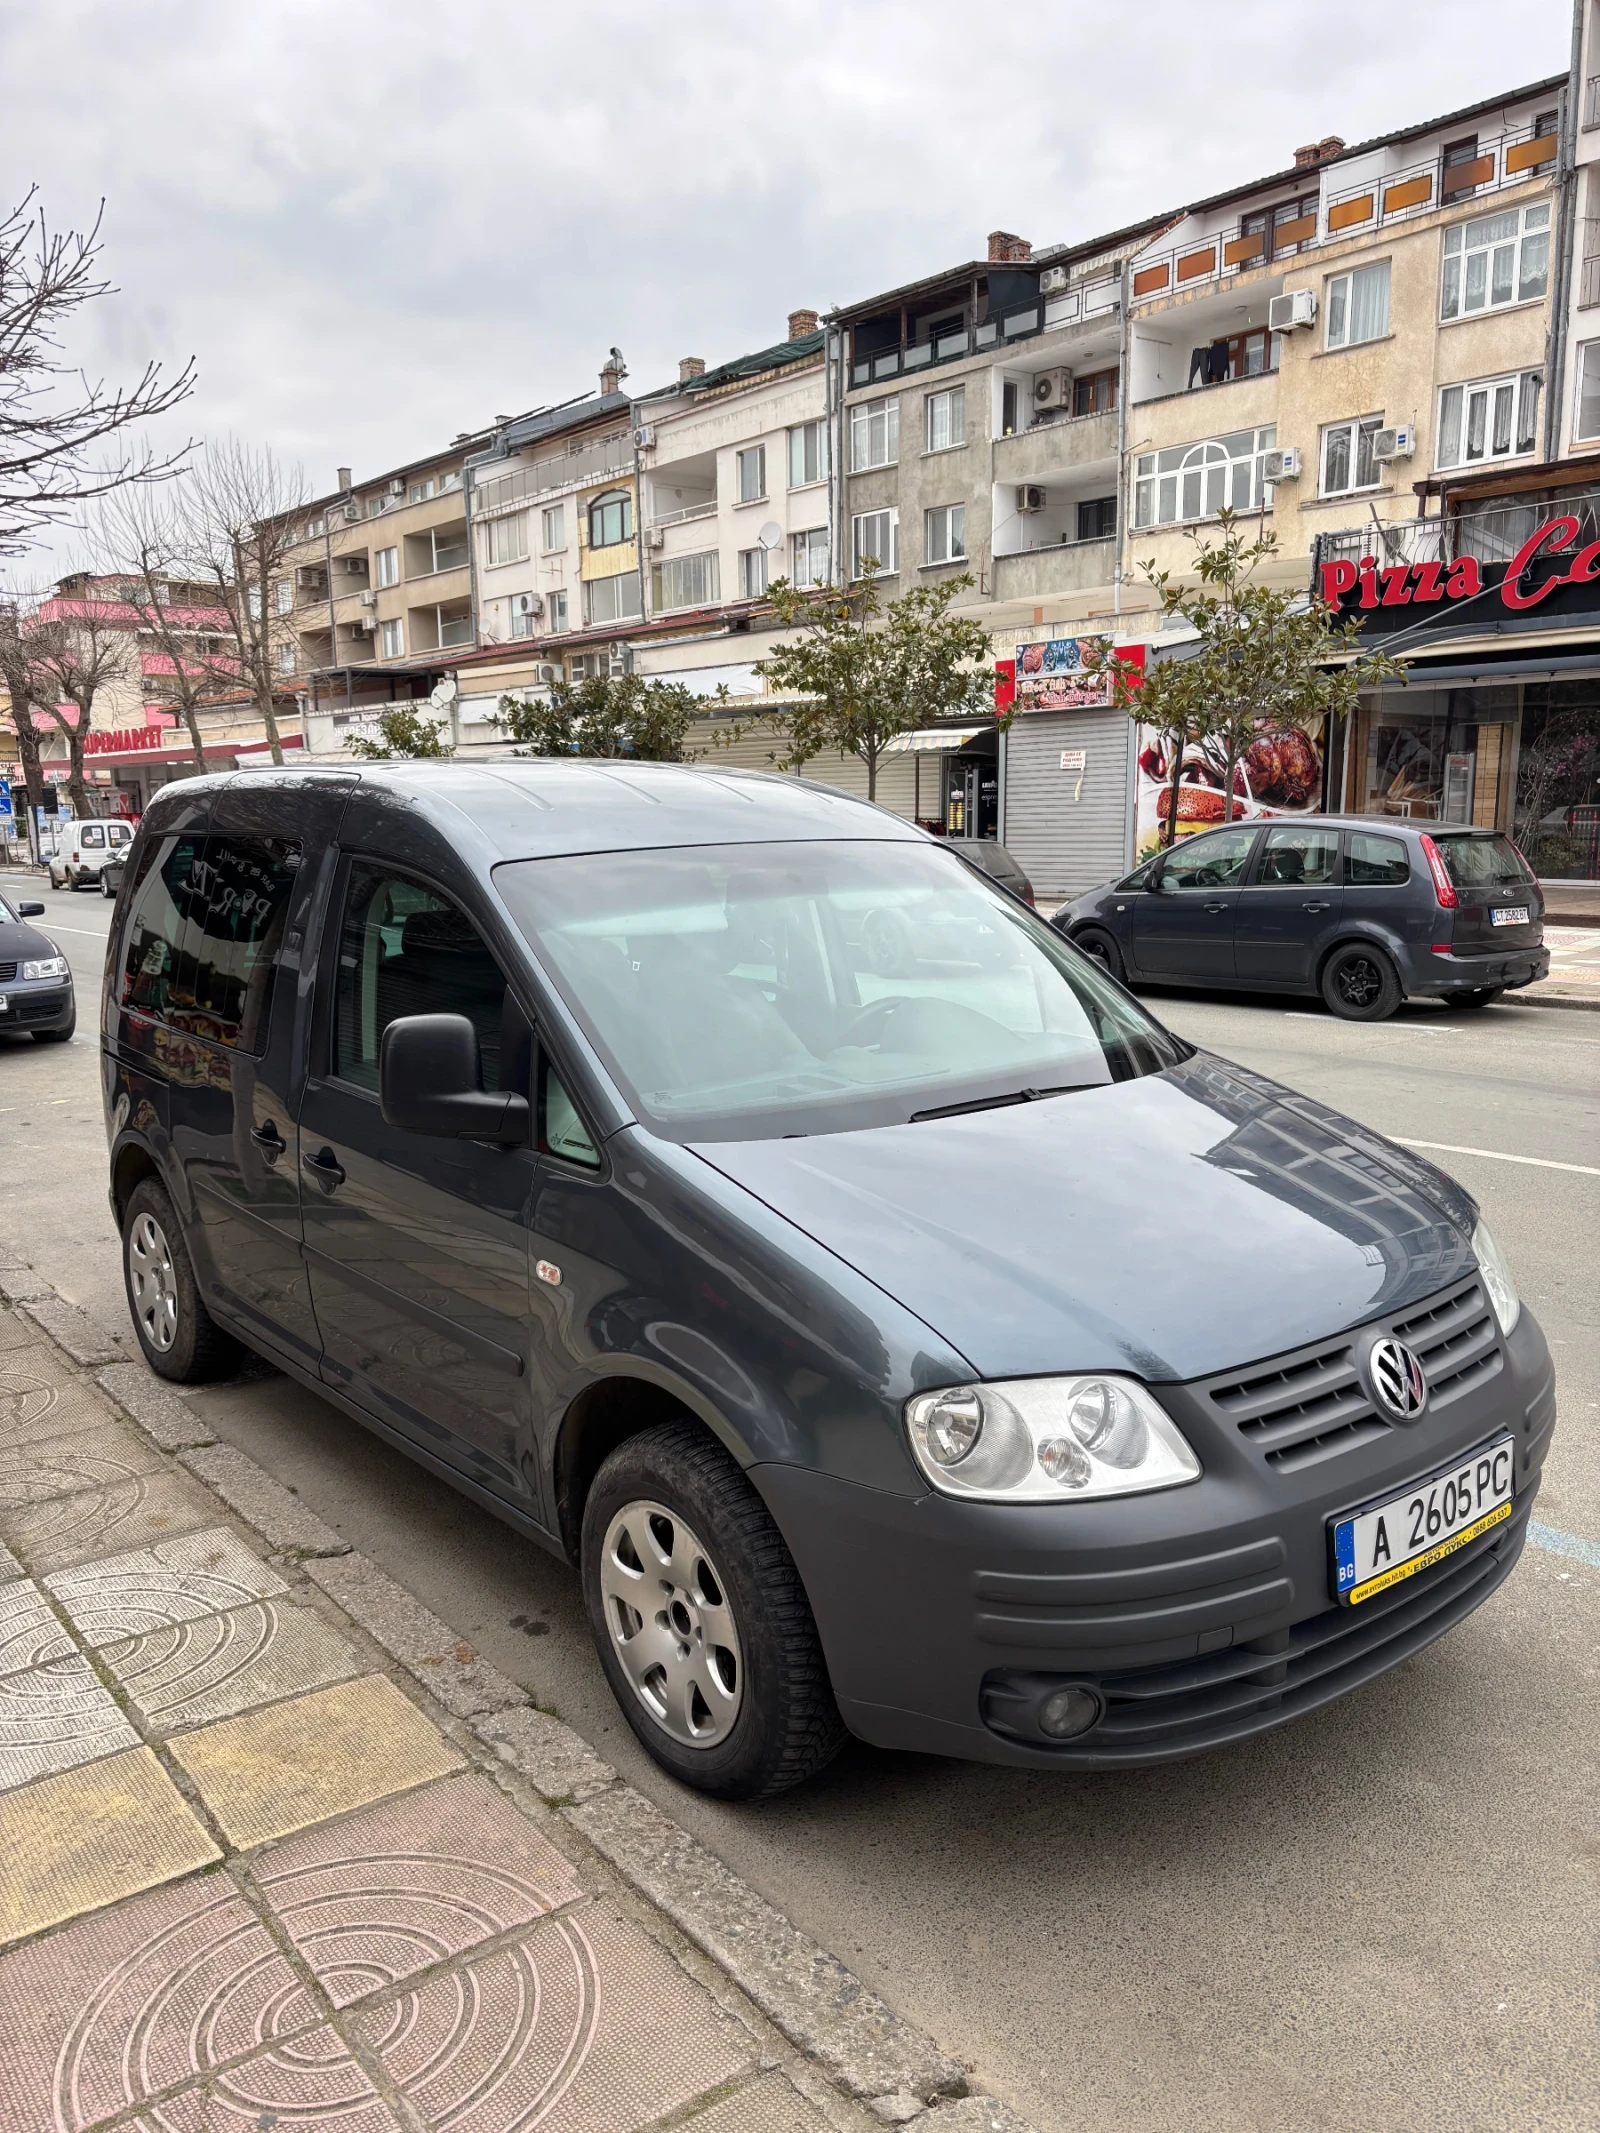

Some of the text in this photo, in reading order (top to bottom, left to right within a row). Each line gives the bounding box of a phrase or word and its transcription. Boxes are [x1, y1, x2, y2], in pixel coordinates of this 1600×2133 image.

[1320, 555, 1484, 612] Pizza
[1372, 1515, 1391, 1568] A
[1408, 1470, 1472, 1550] 2605
[1472, 1507, 1508, 1537] 0888 606 537
[1339, 1563, 1354, 1583] BG
[1413, 1535, 1468, 1573] ЕВРО ЛУКС
